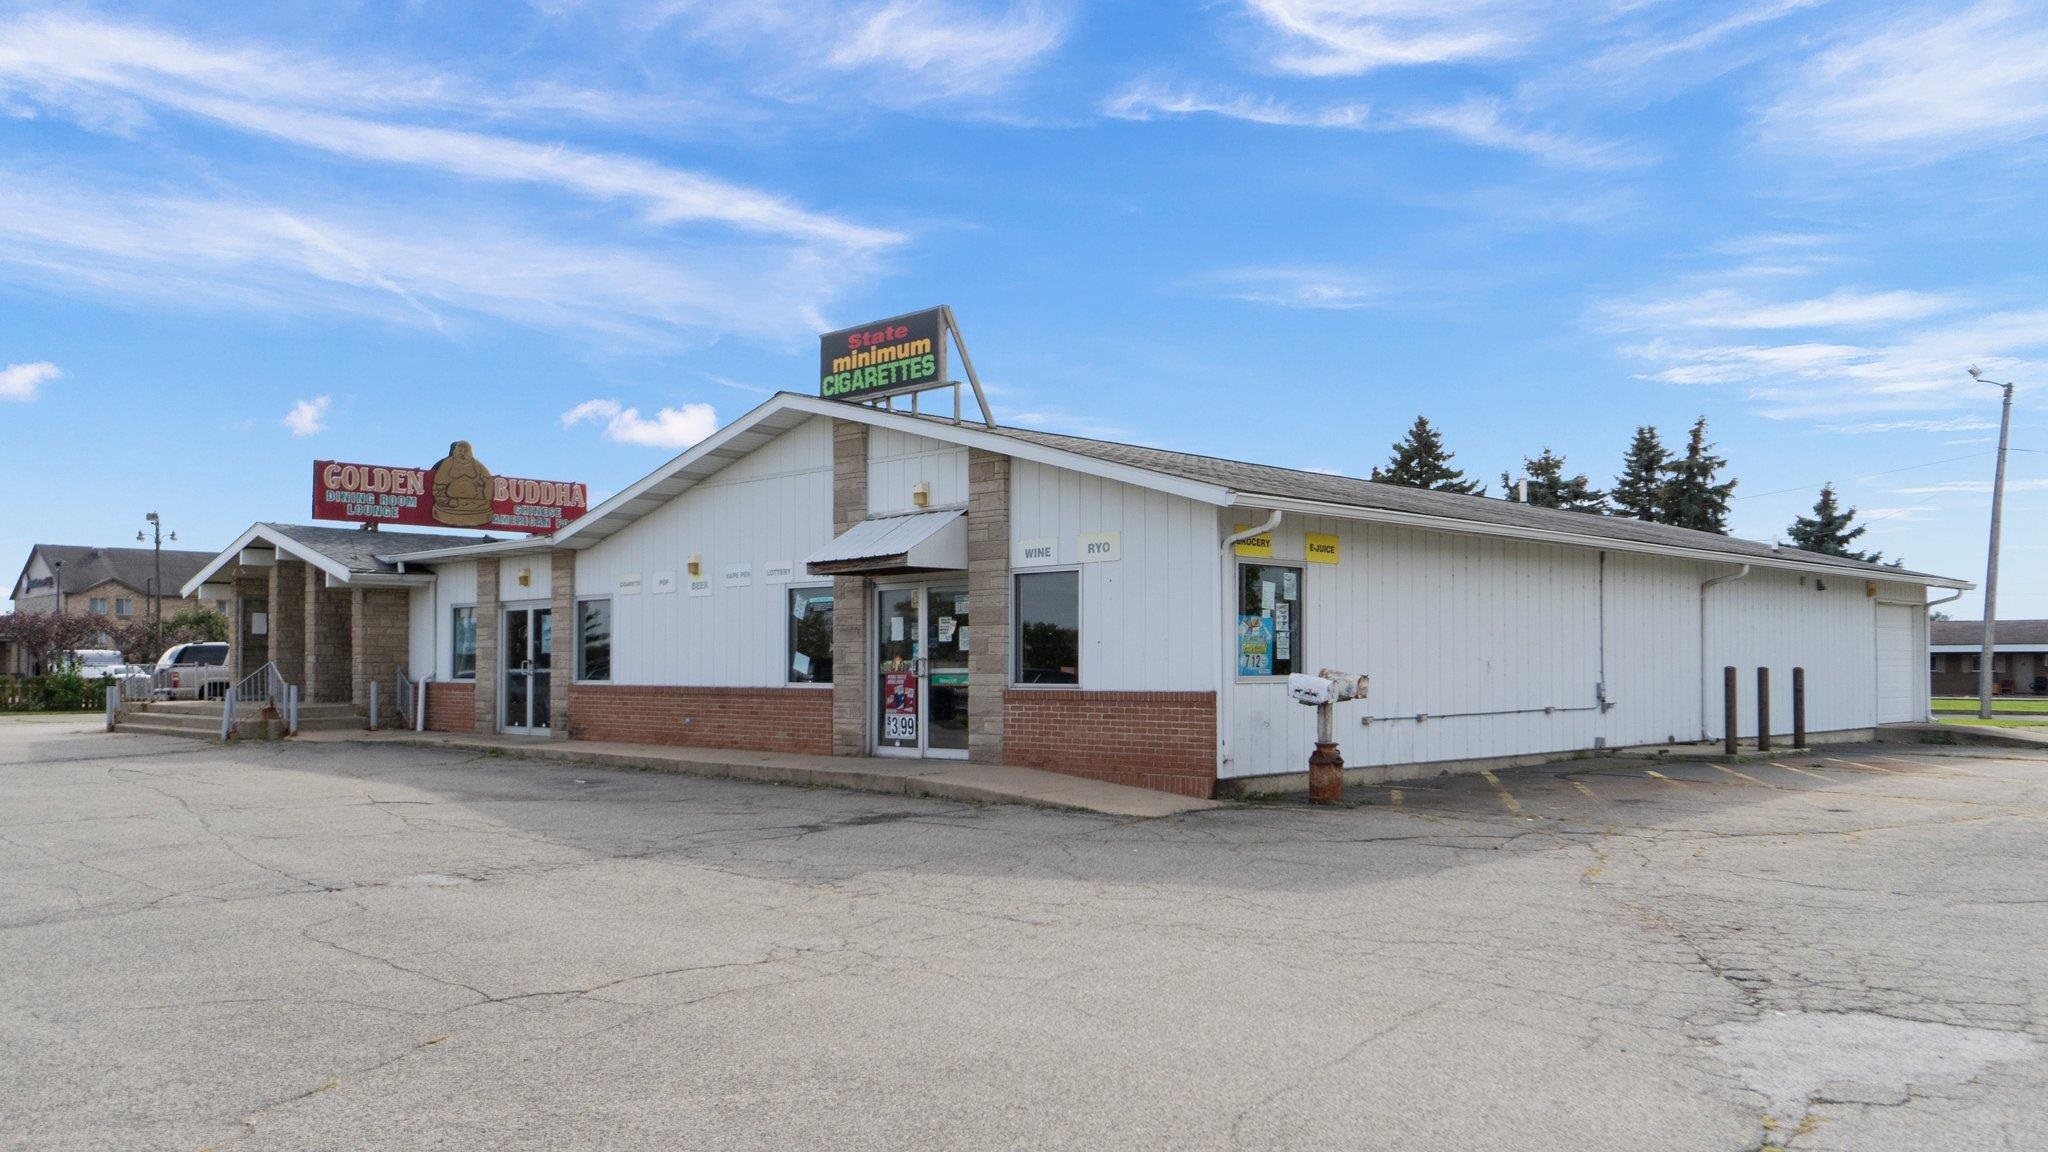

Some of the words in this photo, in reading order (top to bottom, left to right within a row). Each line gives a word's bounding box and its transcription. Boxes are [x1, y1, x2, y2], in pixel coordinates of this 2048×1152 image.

[848, 326, 908, 349] State
[832, 338, 931, 373] minimum
[822, 355, 935, 396] CIGARETTES
[323, 464, 424, 495] GOLDEN
[493, 477, 585, 507] BUDDHA
[325, 489, 375, 504] DINING
[380, 494, 418, 507] ROOM
[346, 503, 400, 518] LOUNGE
[514, 505, 562, 518] CHINESE
[491, 513, 551, 528] AMERICAN
[1024, 547, 1051, 559] WINE
[1087, 542, 1111, 554] RYO
[1309, 543, 1335, 554] E-JUICE
[766, 568, 791, 577] LOTTERY
[691, 581, 709, 590] BEER
[887, 716, 915, 736] $3.99
